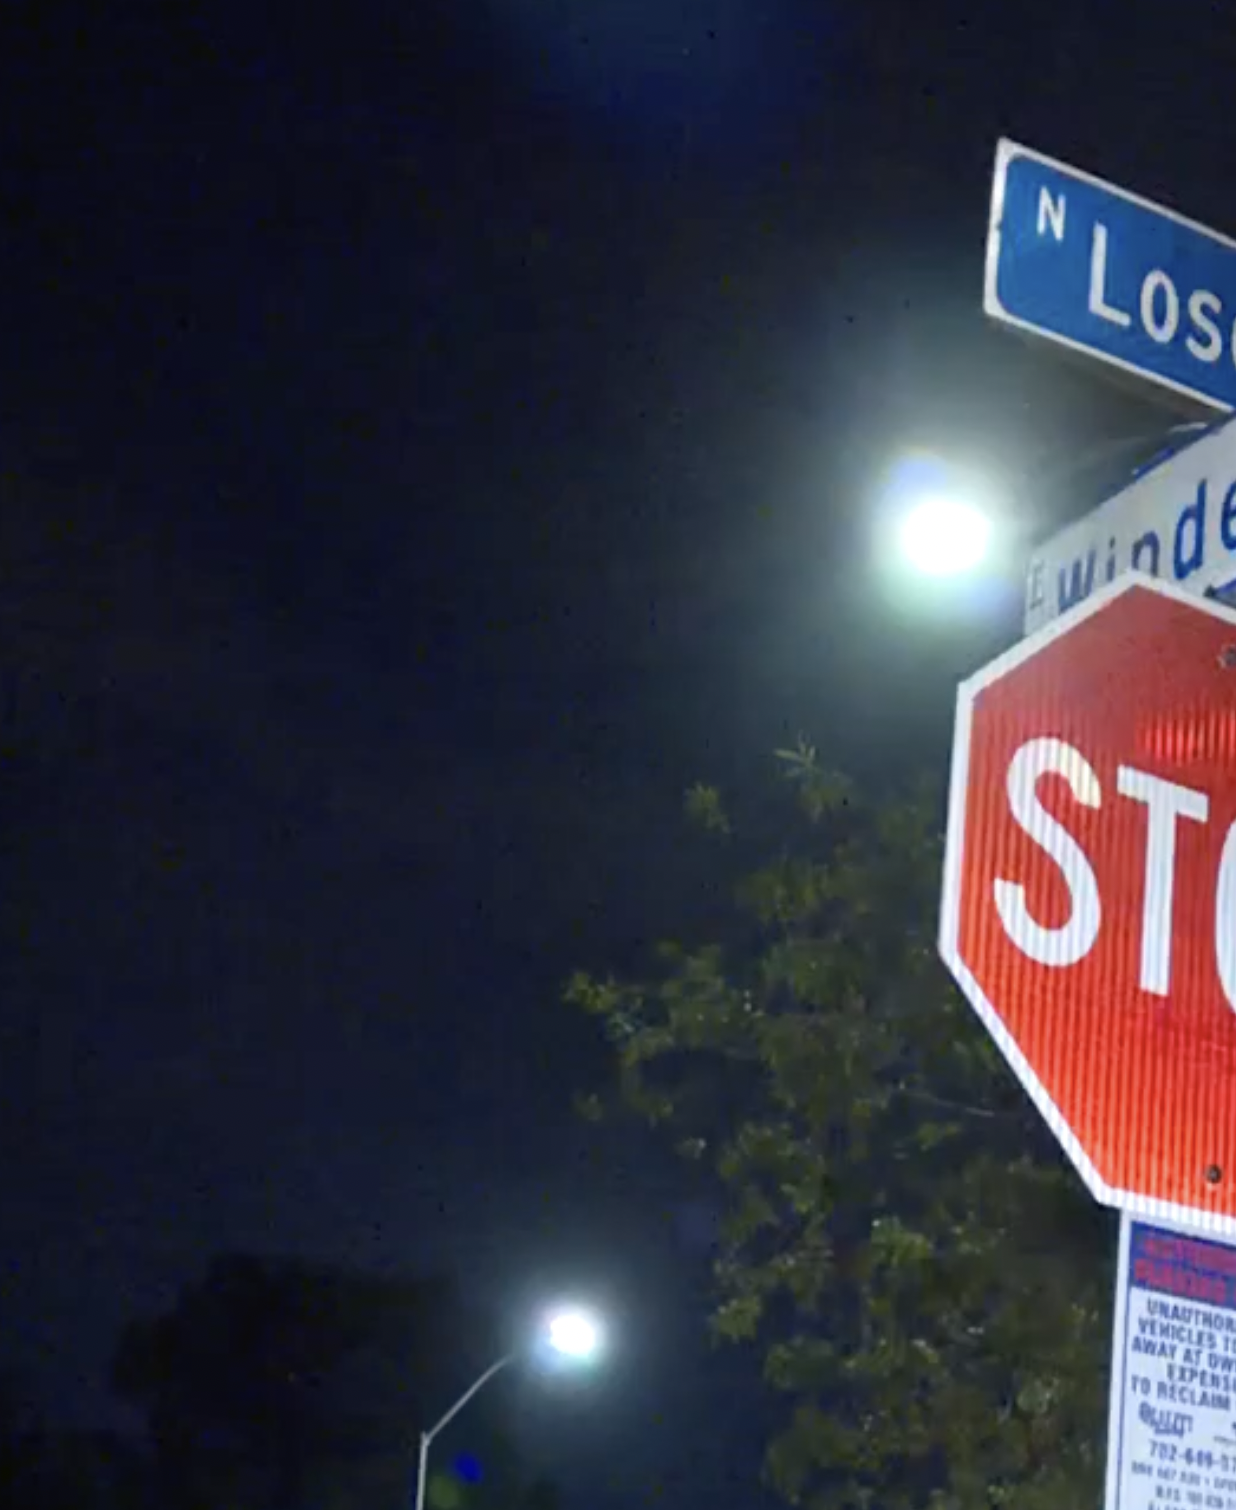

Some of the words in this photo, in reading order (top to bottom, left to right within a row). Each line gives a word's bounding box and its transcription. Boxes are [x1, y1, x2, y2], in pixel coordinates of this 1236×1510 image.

[1037, 187, 1066, 240] N
[1138, 1317, 1217, 1349] VEHICLES
[1131, 1336, 1177, 1359] AWAY
[1183, 1348, 1202, 1366] AT
[1131, 1374, 1151, 1395] TO
[1157, 1381, 1231, 1411] RECLAIM
